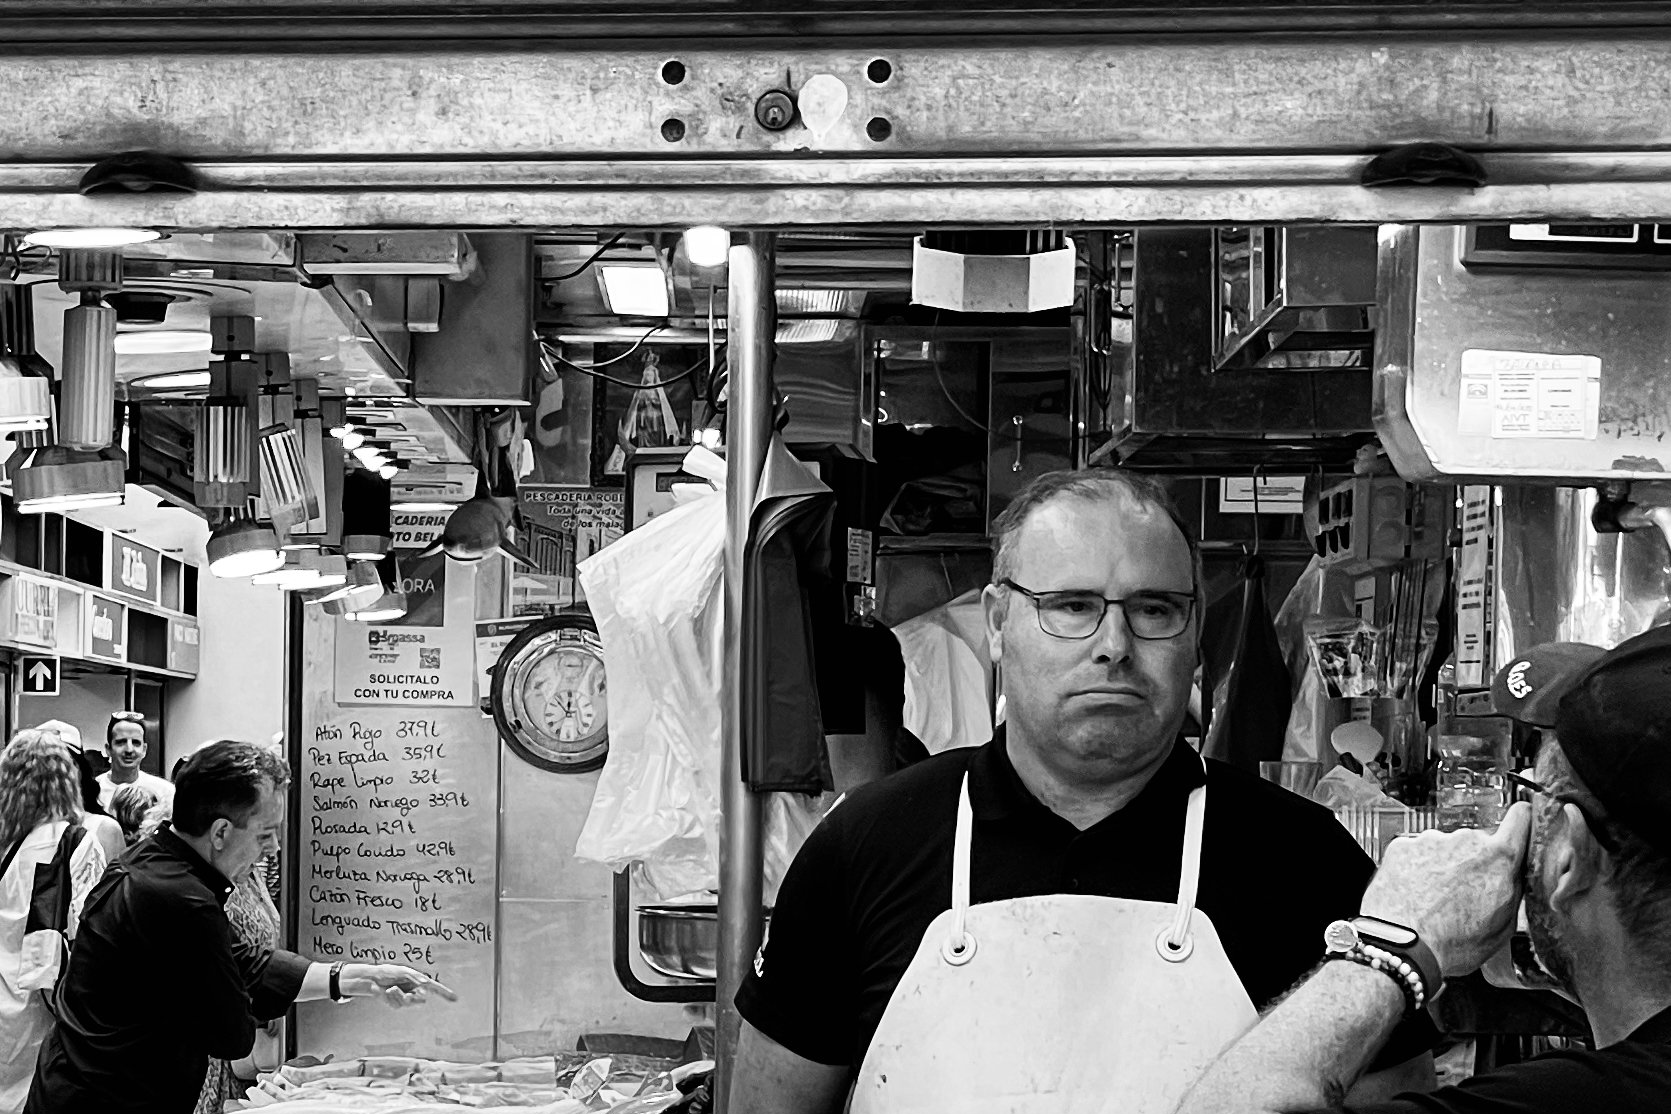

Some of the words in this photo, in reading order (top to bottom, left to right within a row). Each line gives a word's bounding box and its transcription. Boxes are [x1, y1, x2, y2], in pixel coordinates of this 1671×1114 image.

[525, 492, 593, 502] PESCADERIA
[548, 505, 572, 514] Toda
[574, 506, 593, 515] una
[595, 505, 618, 515] vida
[394, 515, 446, 527] CADERIA
[563, 520, 576, 528] de
[395, 531, 412, 542] TO
[414, 531, 435, 542] BEL
[369, 674, 440, 685] SOLICITALO
[354, 689, 380, 698] CON
[384, 689, 400, 700] TU
[402, 689, 454, 700] COMPRA
[308, 747, 332, 766] Pez
[338, 749, 390, 767] Espada
[310, 771, 347, 794] Rape
[312, 795, 358, 812] Salmón
[311, 816, 371, 836] Rosada
[310, 839, 351, 864] Pulpo
[312, 863, 371, 881] Merluza
[355, 889, 403, 910] Fresco
[311, 908, 382, 935] Lenguado
[313, 936, 344, 955] Mero
